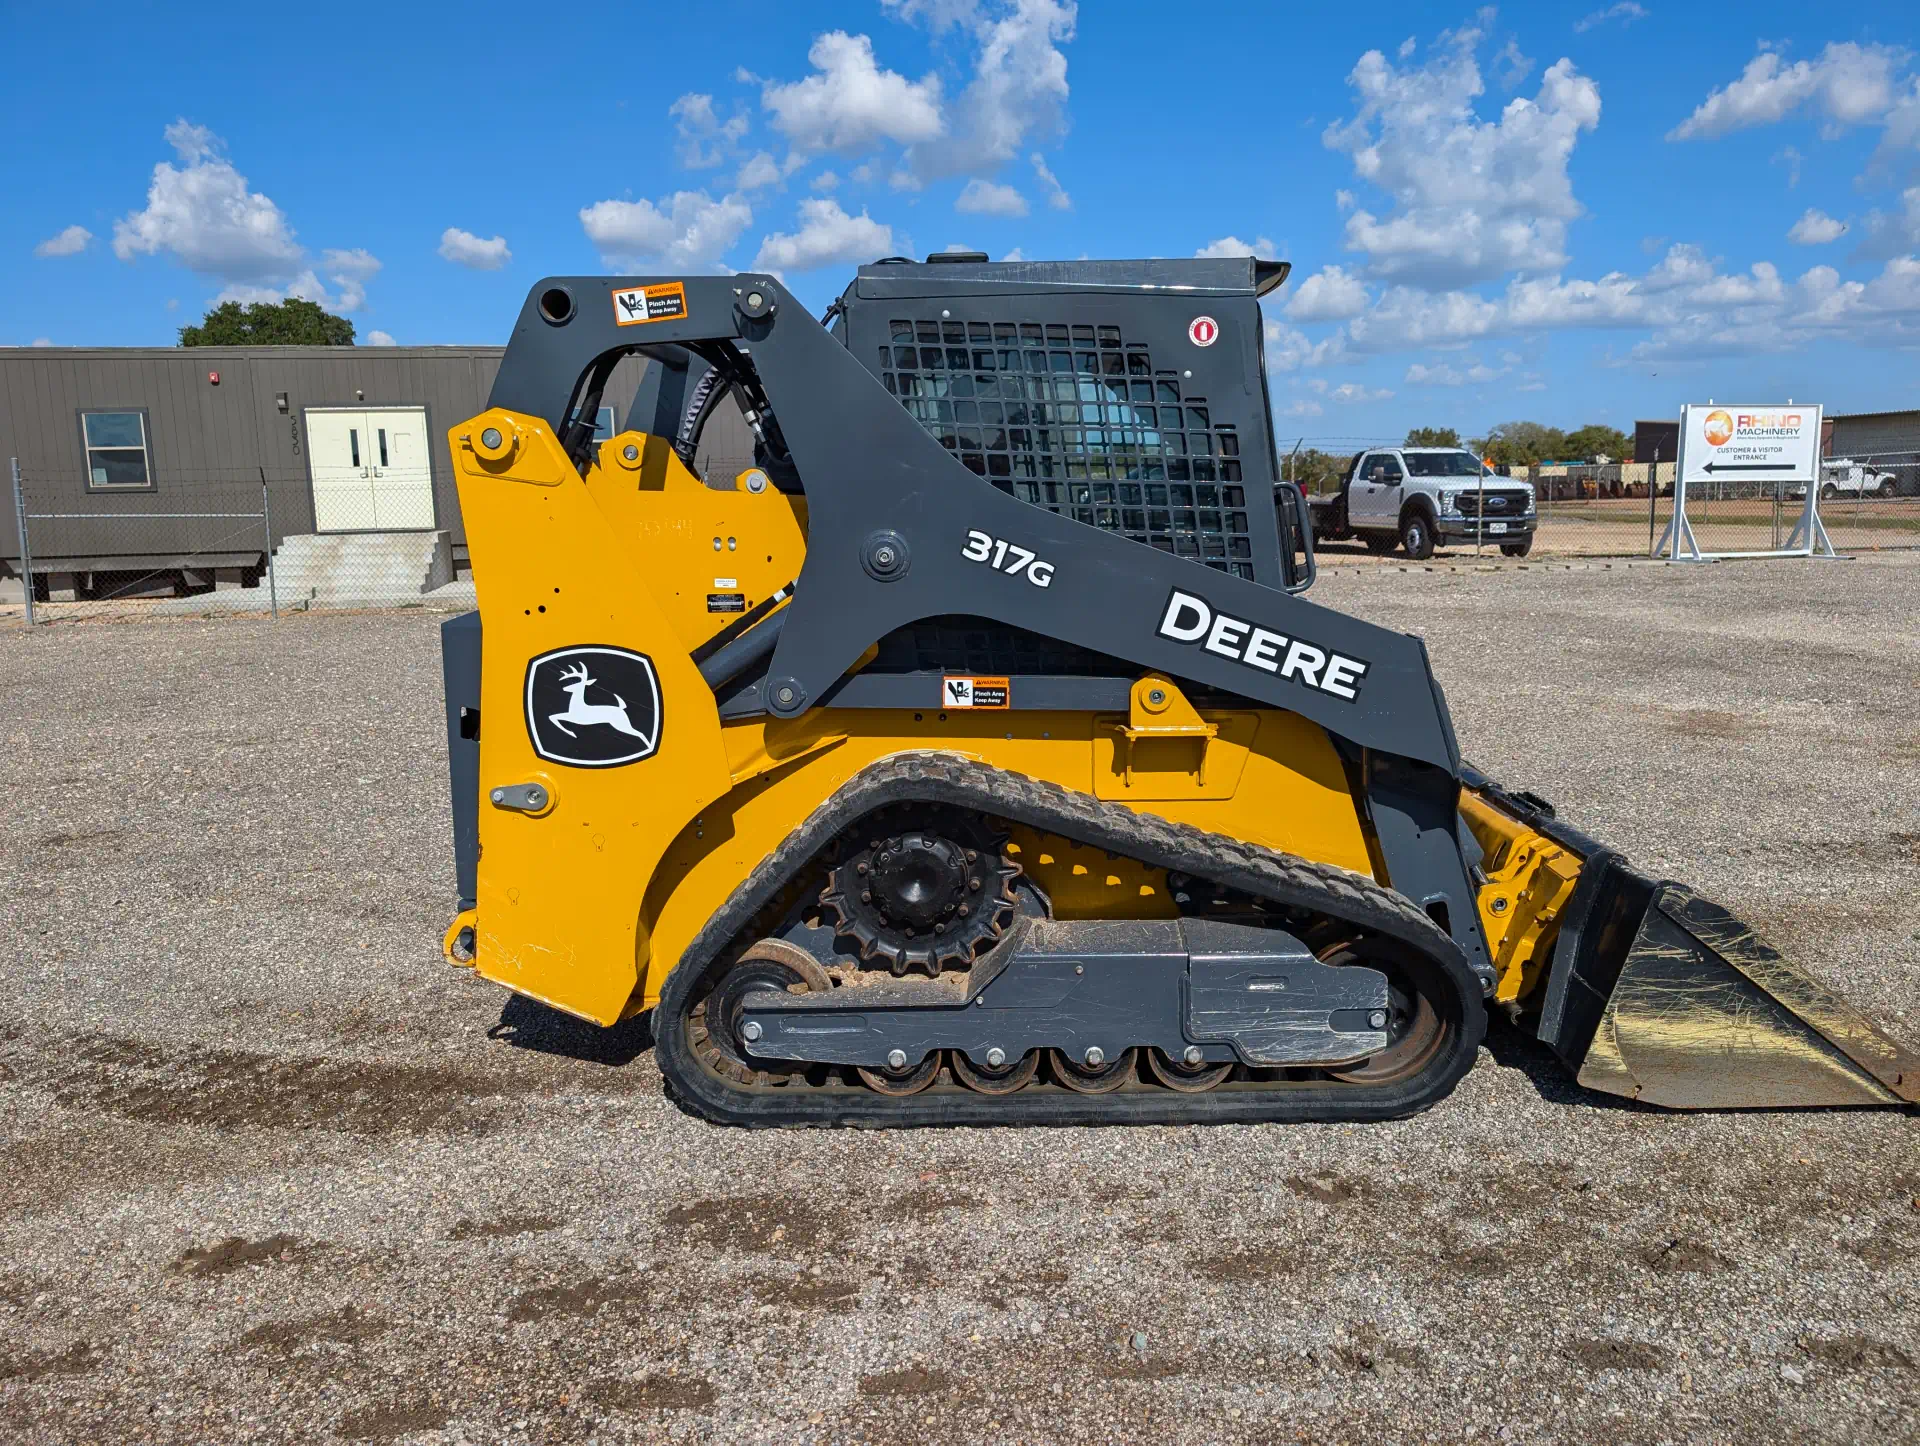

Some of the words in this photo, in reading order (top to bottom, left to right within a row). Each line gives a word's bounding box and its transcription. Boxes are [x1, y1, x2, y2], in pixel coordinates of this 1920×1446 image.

[1736, 428, 1800, 436] MACHINERY
[1737, 414, 1802, 428] RHINO
[962, 530, 1055, 588] 317G
[1160, 591, 1366, 699] DEERE
